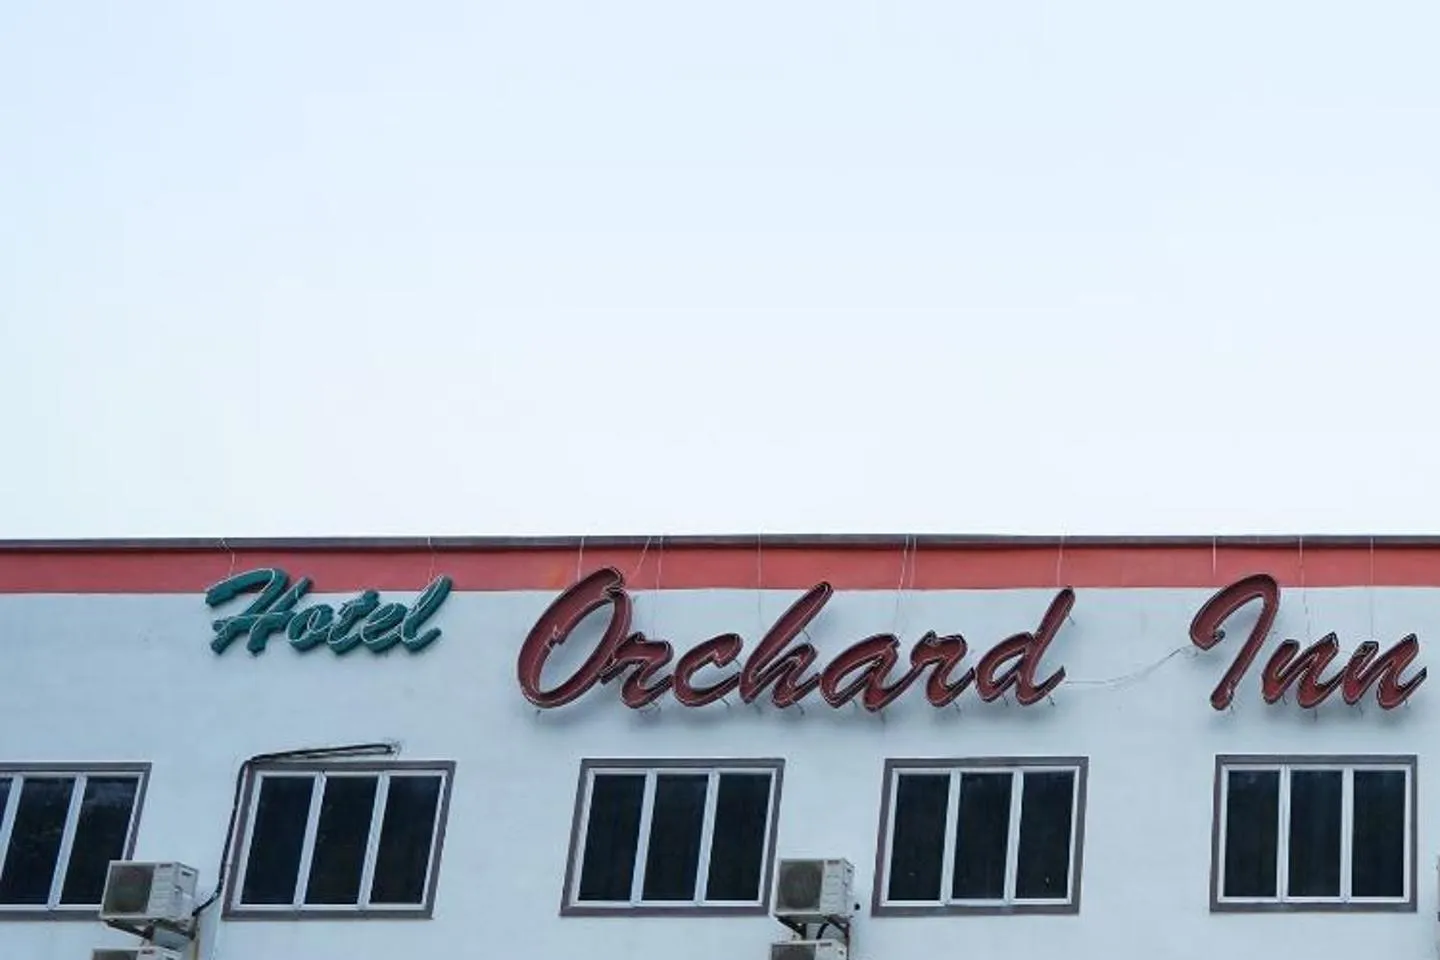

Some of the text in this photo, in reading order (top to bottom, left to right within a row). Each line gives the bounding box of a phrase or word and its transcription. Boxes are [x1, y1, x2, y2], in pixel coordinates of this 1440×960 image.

[204, 565, 1428, 711] Hotel Orchard Inn
